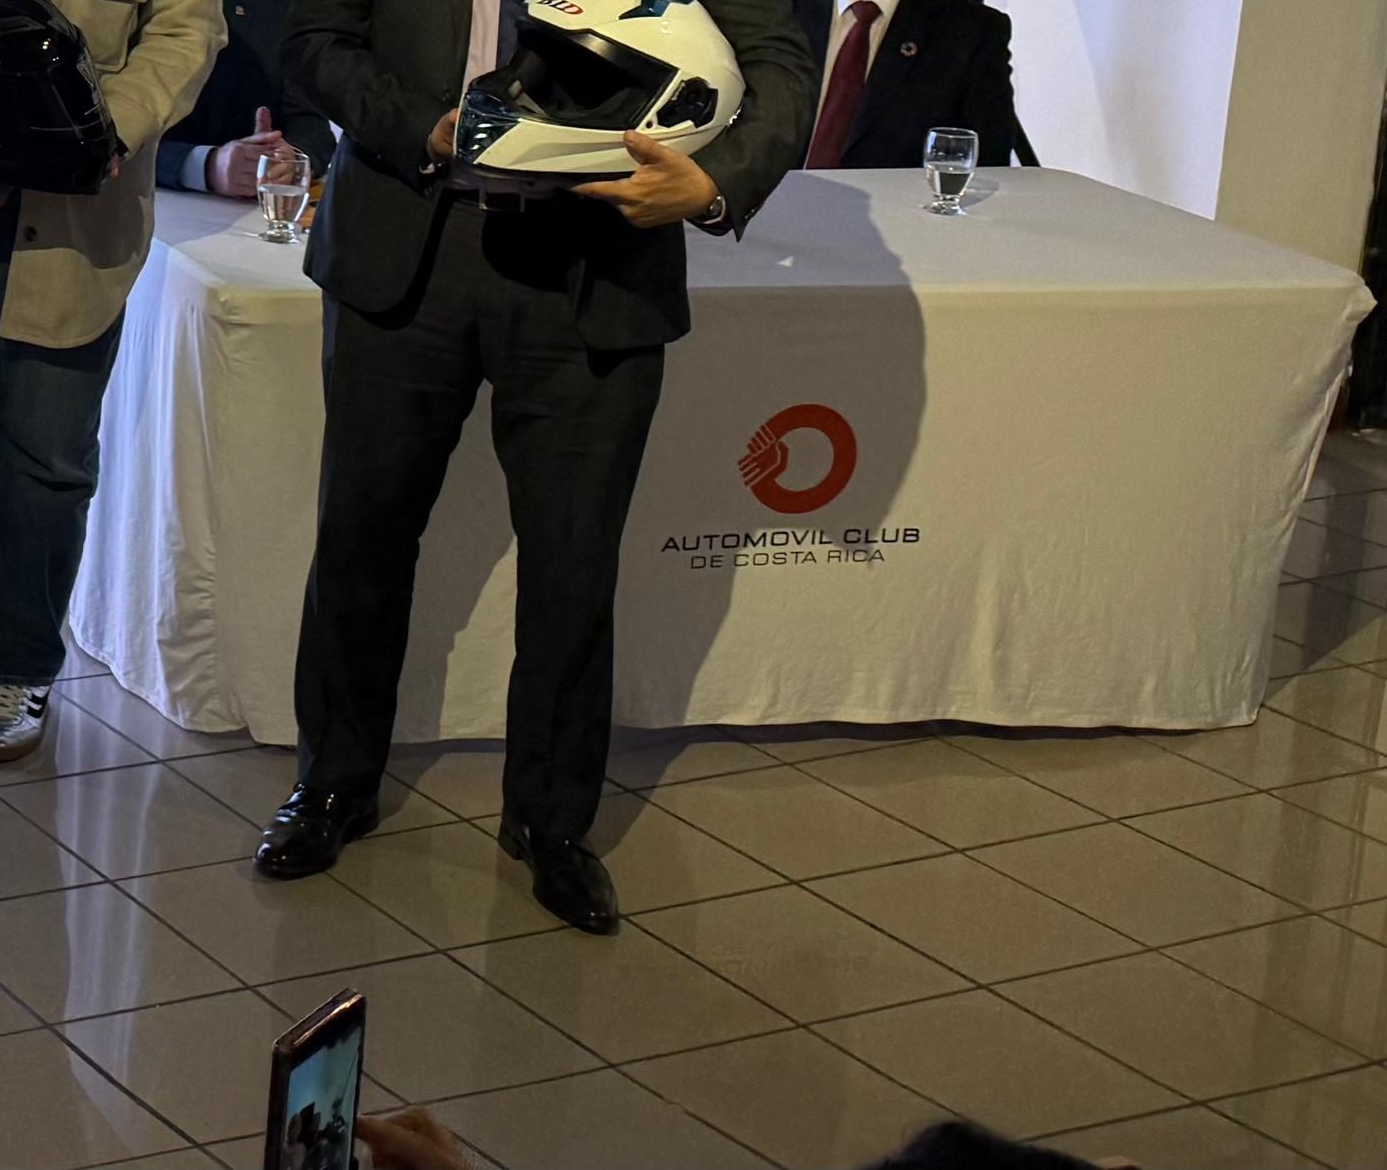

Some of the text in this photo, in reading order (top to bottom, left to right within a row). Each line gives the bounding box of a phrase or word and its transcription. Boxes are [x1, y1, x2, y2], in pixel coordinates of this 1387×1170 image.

[661, 527, 921, 552] AUTOMOVIL CLUB
[690, 548, 886, 570] DE COSTA RICA
